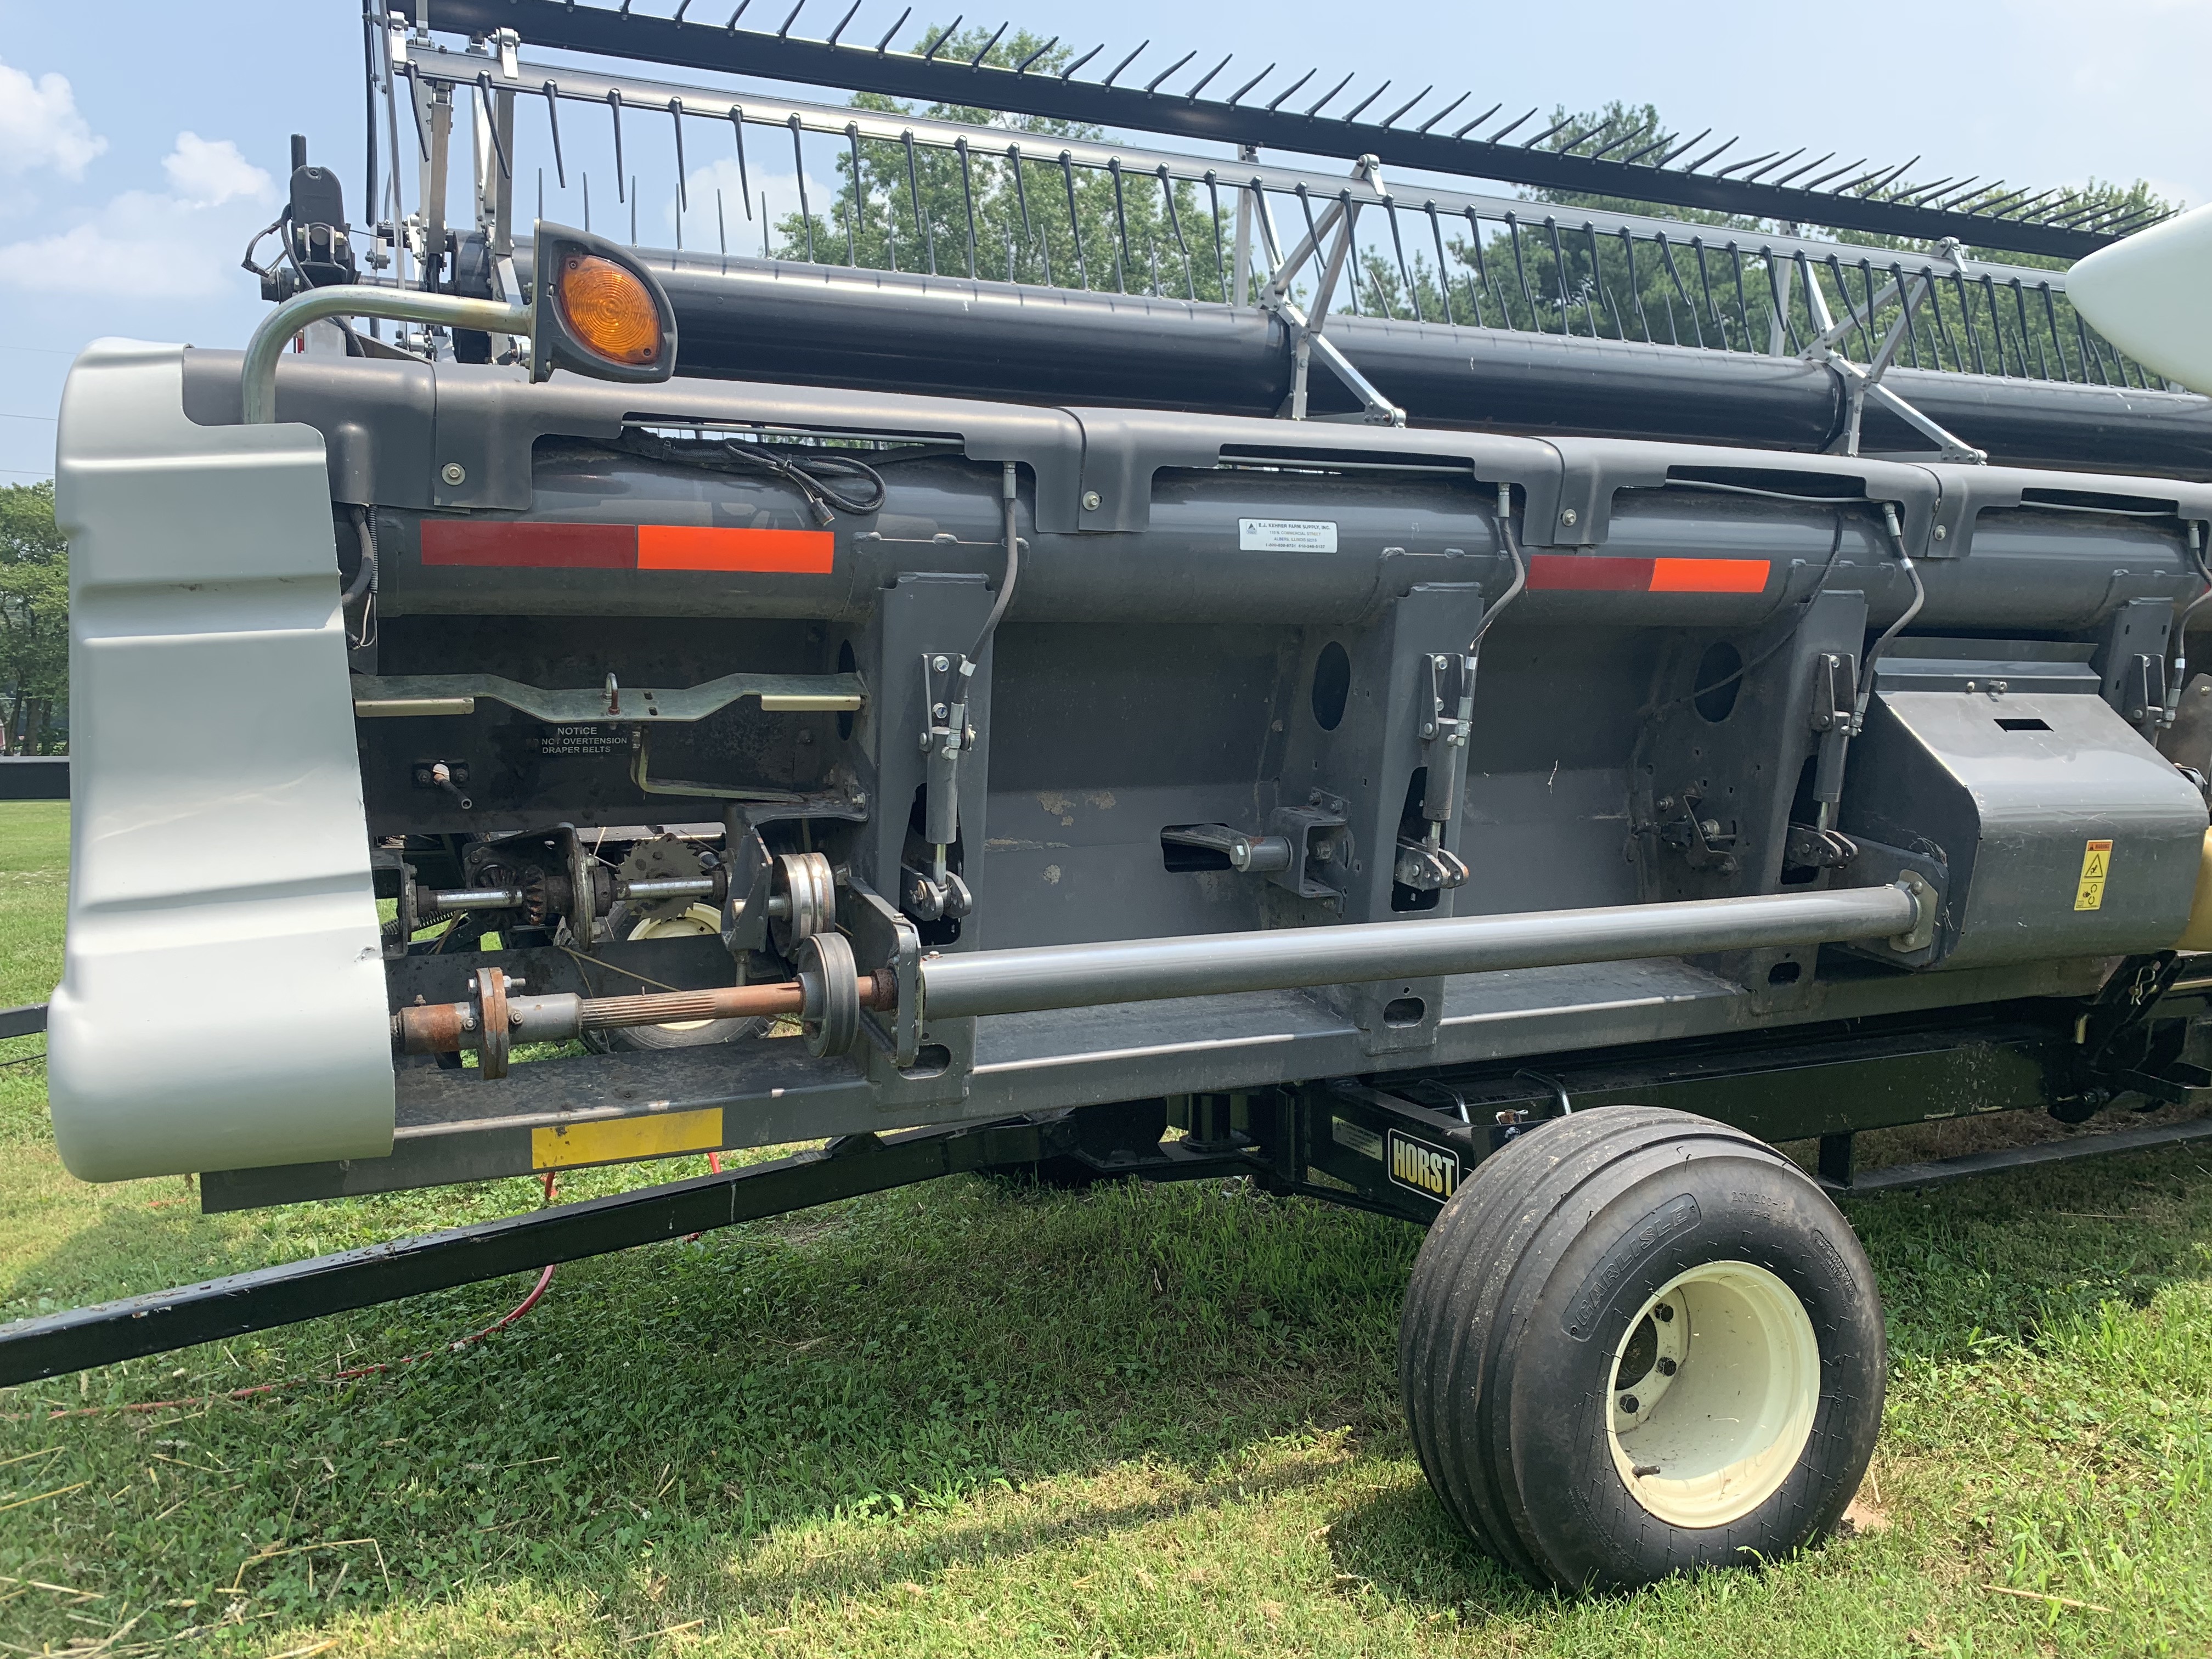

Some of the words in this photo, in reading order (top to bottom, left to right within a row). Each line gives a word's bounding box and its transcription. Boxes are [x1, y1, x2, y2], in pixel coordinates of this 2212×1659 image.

[557, 727, 597, 735] NOTICE
[1393, 1138, 1454, 1197] HORST
[1576, 1205, 1688, 1325] CARLISLE
